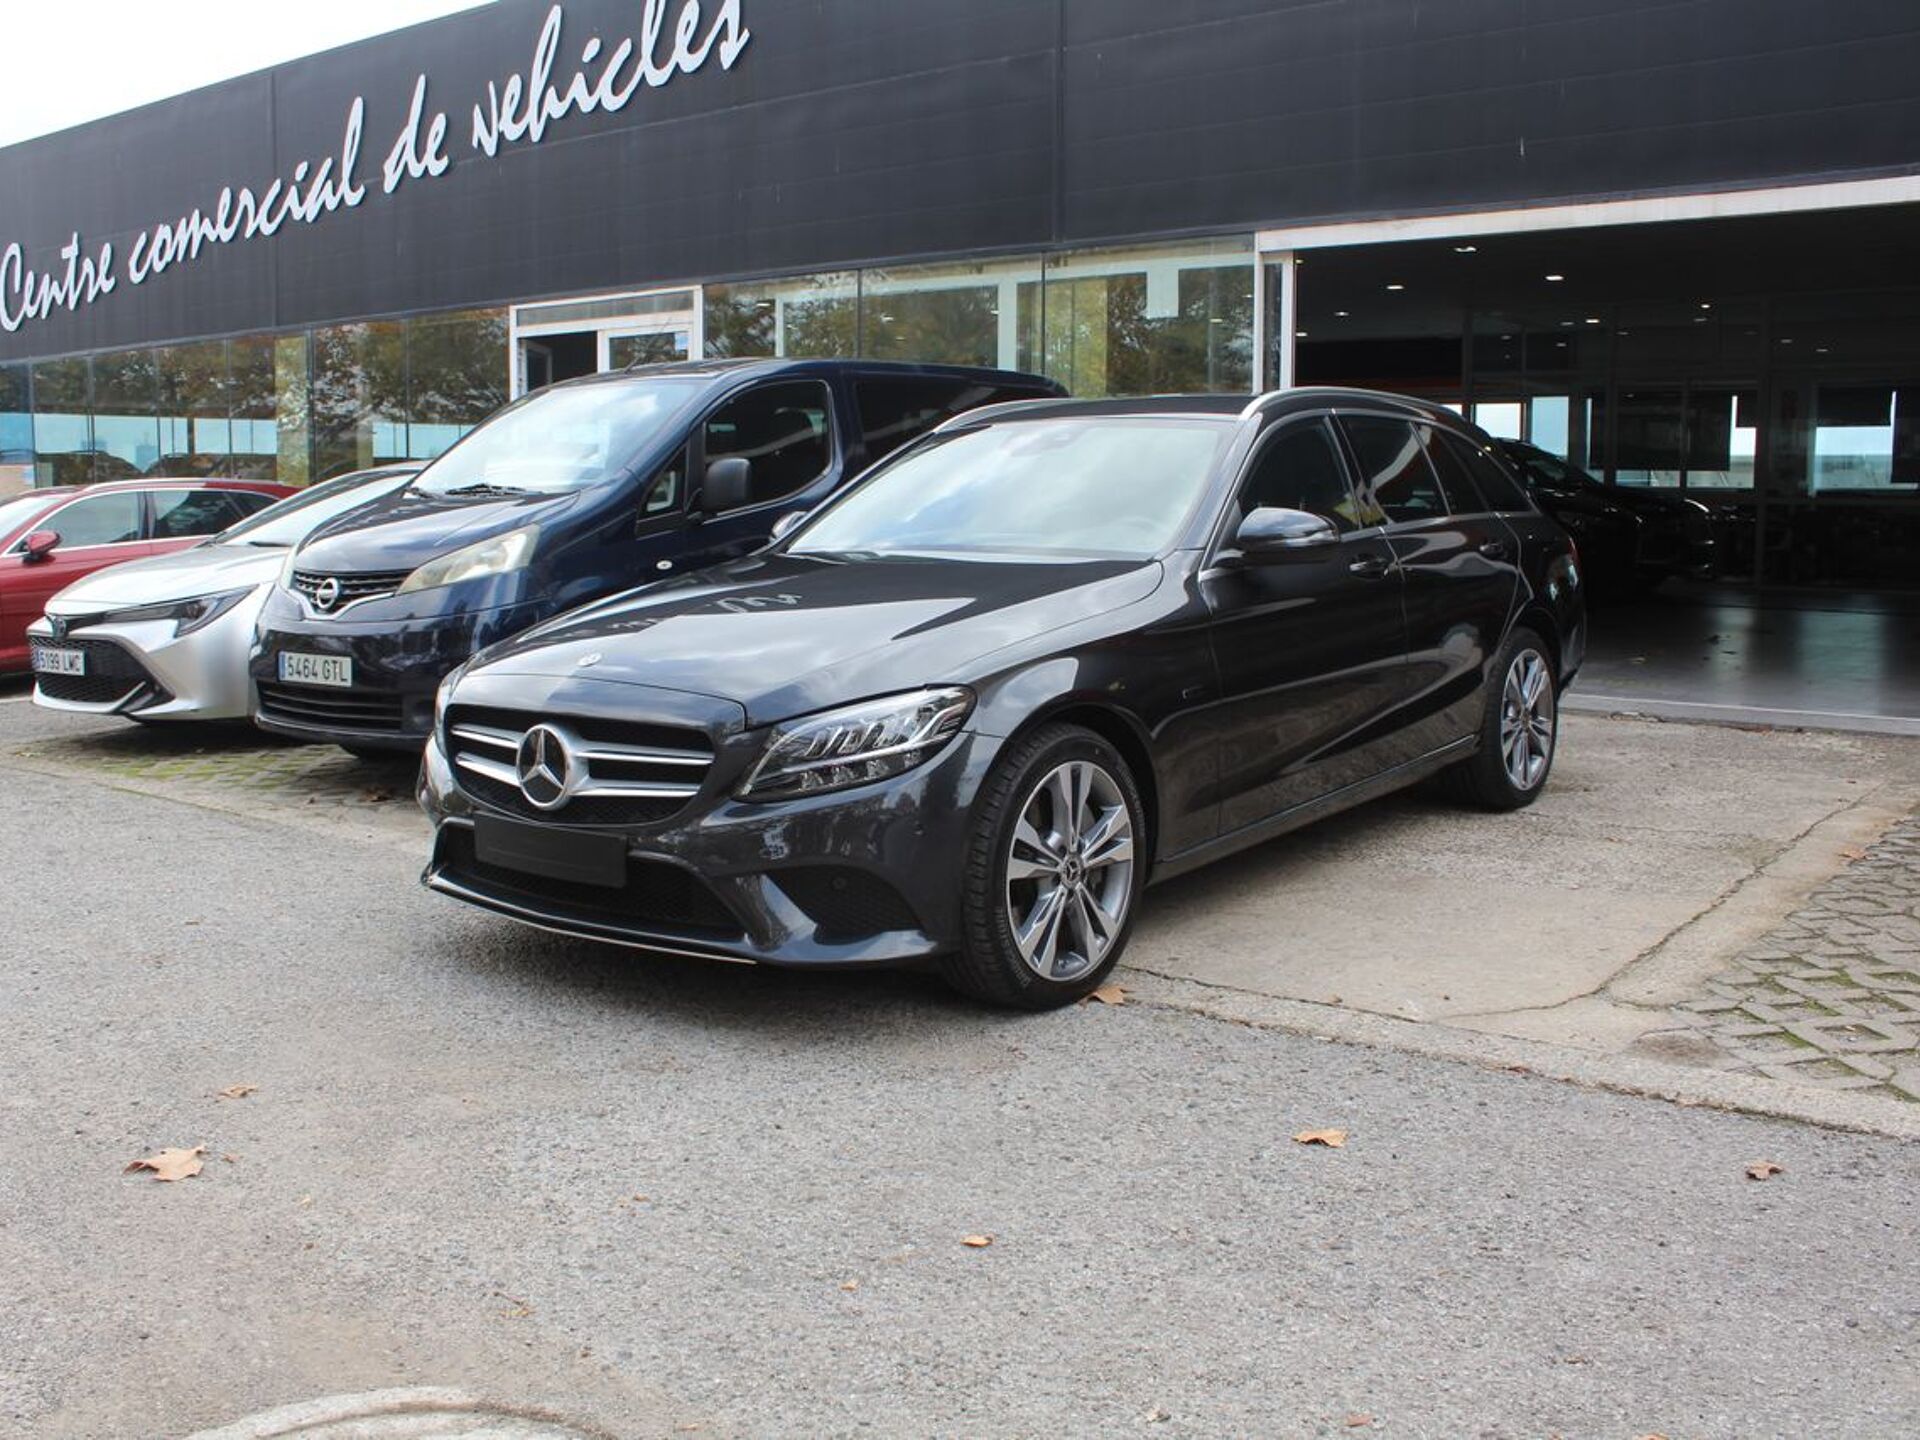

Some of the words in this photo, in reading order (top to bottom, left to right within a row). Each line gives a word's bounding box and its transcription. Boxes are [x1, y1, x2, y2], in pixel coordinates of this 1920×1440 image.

[0, 231, 116, 332] Centre
[127, 95, 365, 284] comercial
[382, 73, 449, 193] de
[472, 0, 750, 157] vehicles
[287, 655, 318, 678] 5464
[321, 659, 348, 682] GTL
